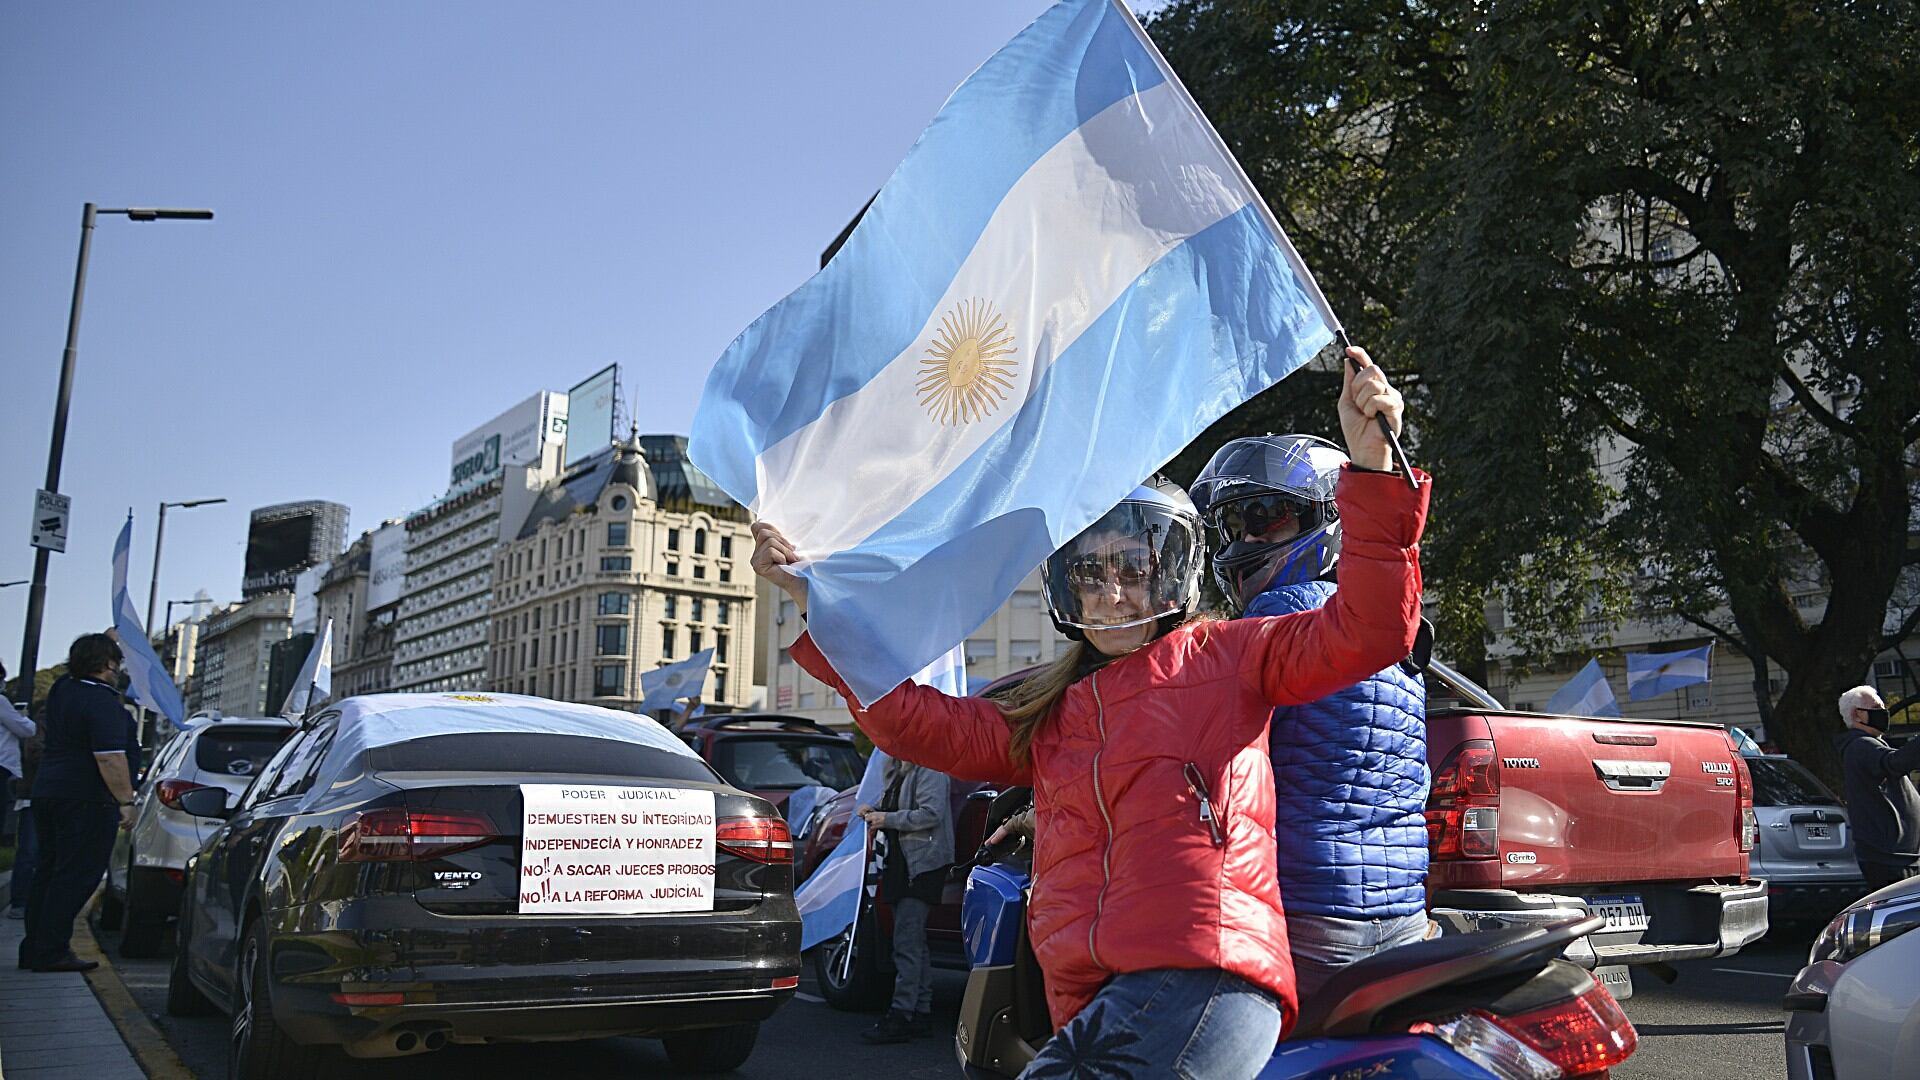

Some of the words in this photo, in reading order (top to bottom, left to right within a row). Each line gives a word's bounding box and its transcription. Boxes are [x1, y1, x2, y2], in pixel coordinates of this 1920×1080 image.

[1502, 757, 1541, 769] TOYOTA
[1701, 761, 1732, 774] HILUX
[1715, 777, 1734, 786] SRX
[561, 789, 606, 800] PODER
[618, 790, 677, 800] JUDICIAL
[528, 814, 616, 825] DEMUESTREN
[621, 814, 638, 825] SU
[626, 838, 634, 850] Y
[636, 838, 704, 850] HONRADEZ
[1508, 853, 1536, 863] Cerrito
[434, 871, 482, 879] VENTO
[553, 864, 564, 876] A
[567, 864, 611, 876] SACAR
[615, 863, 665, 876] JUECES
[667, 864, 716, 876] PROBOS
[551, 891, 561, 903] A
[565, 890, 582, 902] LA
[584, 889, 644, 902] REFORMA
[1626, 905, 1644, 926] DH
